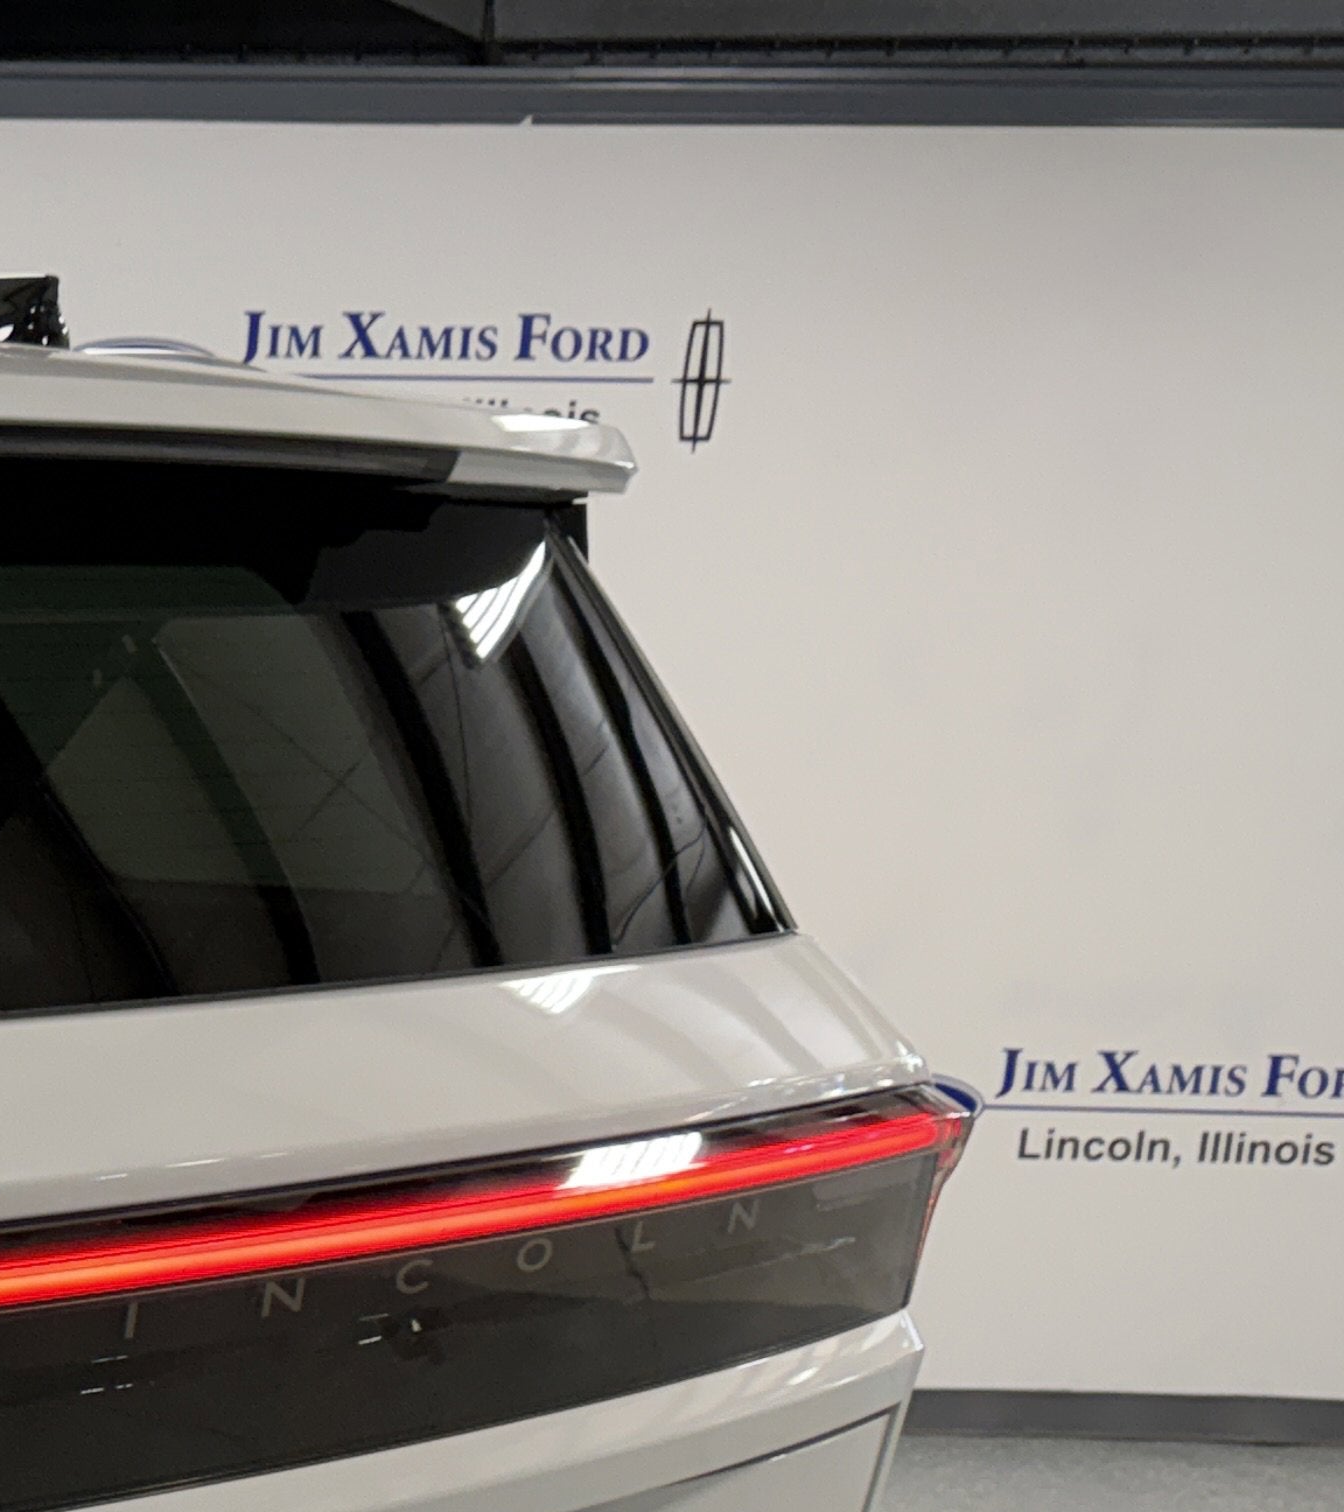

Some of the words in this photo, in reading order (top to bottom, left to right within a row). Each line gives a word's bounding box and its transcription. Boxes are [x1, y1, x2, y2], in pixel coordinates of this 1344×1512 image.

[242, 310, 324, 364] JIM
[338, 311, 498, 362] XAMIS
[513, 313, 650, 362] FORD
[995, 1047, 1079, 1098] JIM
[1092, 1050, 1247, 1098] XAMIS
[1017, 1127, 1182, 1169] Lincoln,
[1197, 1131, 1336, 1166] Illinois
